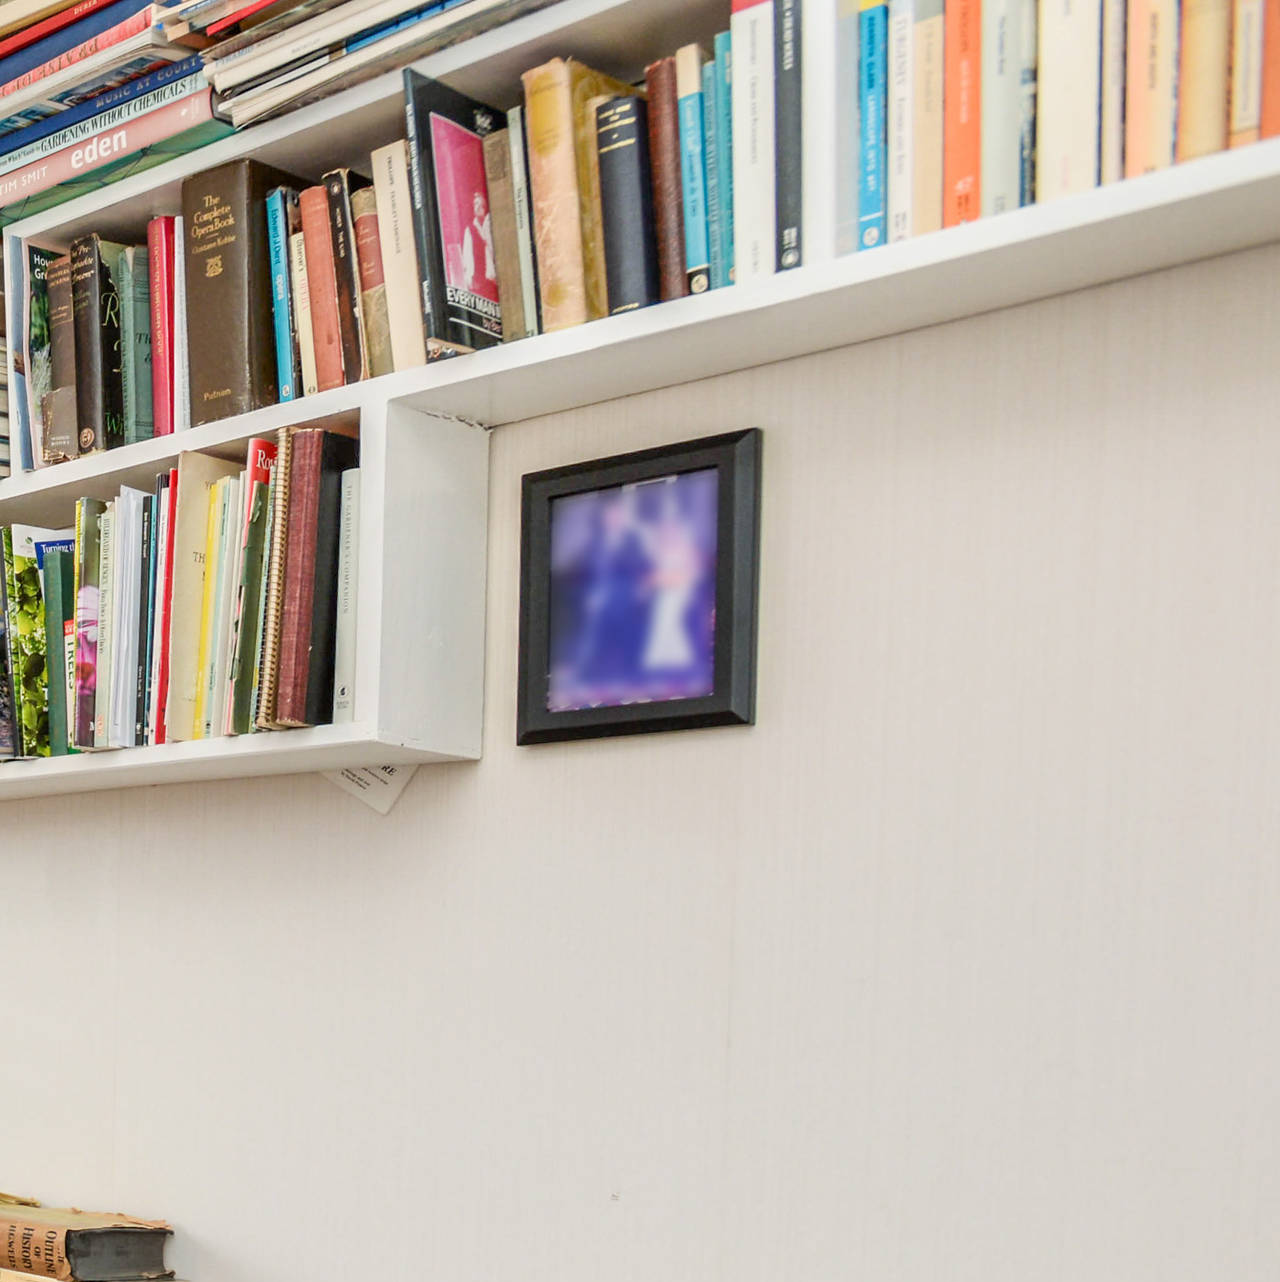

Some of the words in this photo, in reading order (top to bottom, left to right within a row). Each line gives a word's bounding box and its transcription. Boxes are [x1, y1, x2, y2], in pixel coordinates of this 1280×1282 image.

[867, 15, 876, 57] KENNETH
[96, 86, 130, 108] MUSIC
[136, 78, 151, 92] AT
[157, 58, 198, 82] COURT
[867, 61, 876, 89] CLARK
[40, 122, 90, 153] GARDENING
[91, 105, 132, 133] WITHOUT
[134, 82, 186, 113] CHEMICALS
[867, 95, 877, 147] LANDSCAPE
[70, 130, 128, 169] eden
[21, 167, 48, 189] SMIT
[194, 205, 231, 223] Complete
[203, 195, 220, 207] The
[192, 223, 214, 238] Opera
[214, 214, 235, 228] Book
[271, 208, 279, 239] Edward
[274, 246, 282, 265] Dent
[296, 239, 305, 272] Observer's
[447, 287, 474, 310] EVERY
[345, 486, 353, 500] THE
[344, 504, 352, 558] GARDENER'S
[41, 543, 69, 553] Turning
[343, 561, 351, 615] COMPANION
[21, 1227, 35, 1270] HISTORY
[34, 1246, 41, 1258] OF
[45, 1230, 57, 1275] OUTLINE
